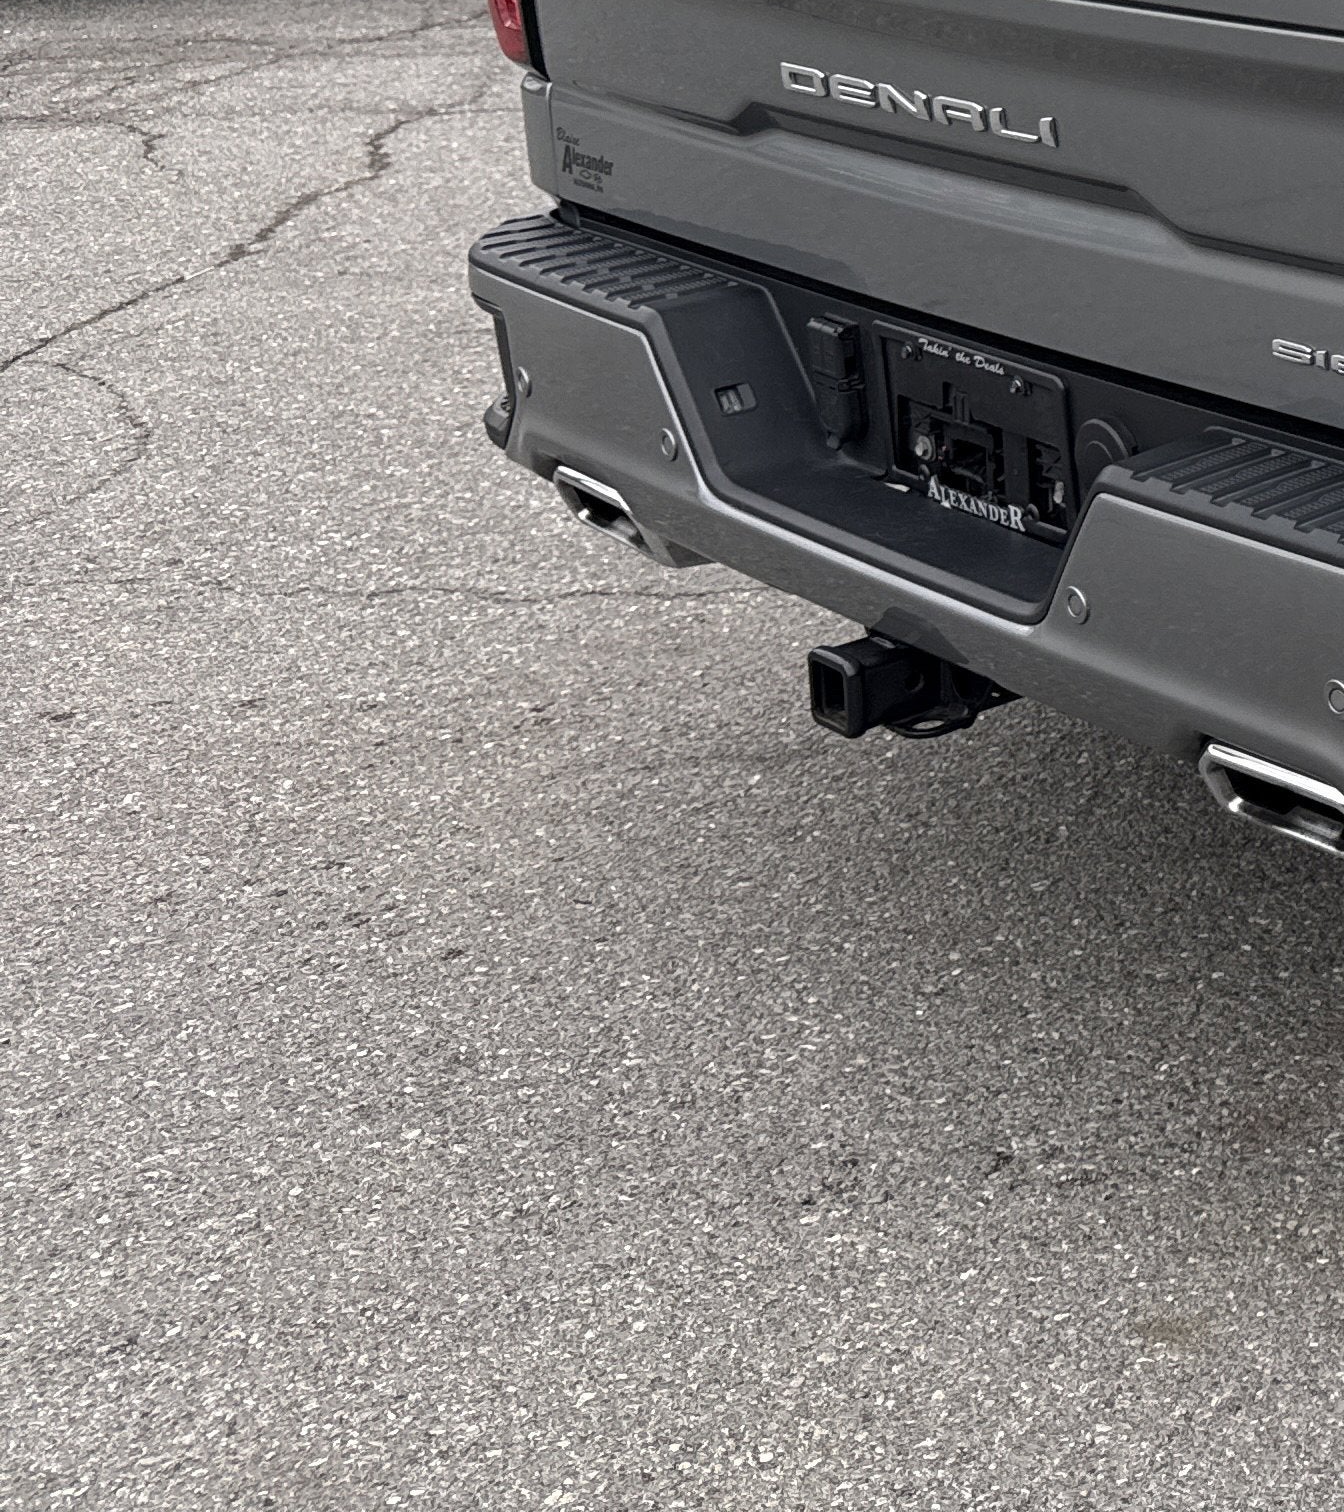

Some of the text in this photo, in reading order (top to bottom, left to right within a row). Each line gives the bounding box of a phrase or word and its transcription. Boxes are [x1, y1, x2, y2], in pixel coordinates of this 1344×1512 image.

[780, 61, 1059, 149] DENALI
[561, 144, 614, 176] Alexander
[918, 337, 1006, 376] Takin' the Deals
[926, 474, 1027, 532] ALEXANDER
